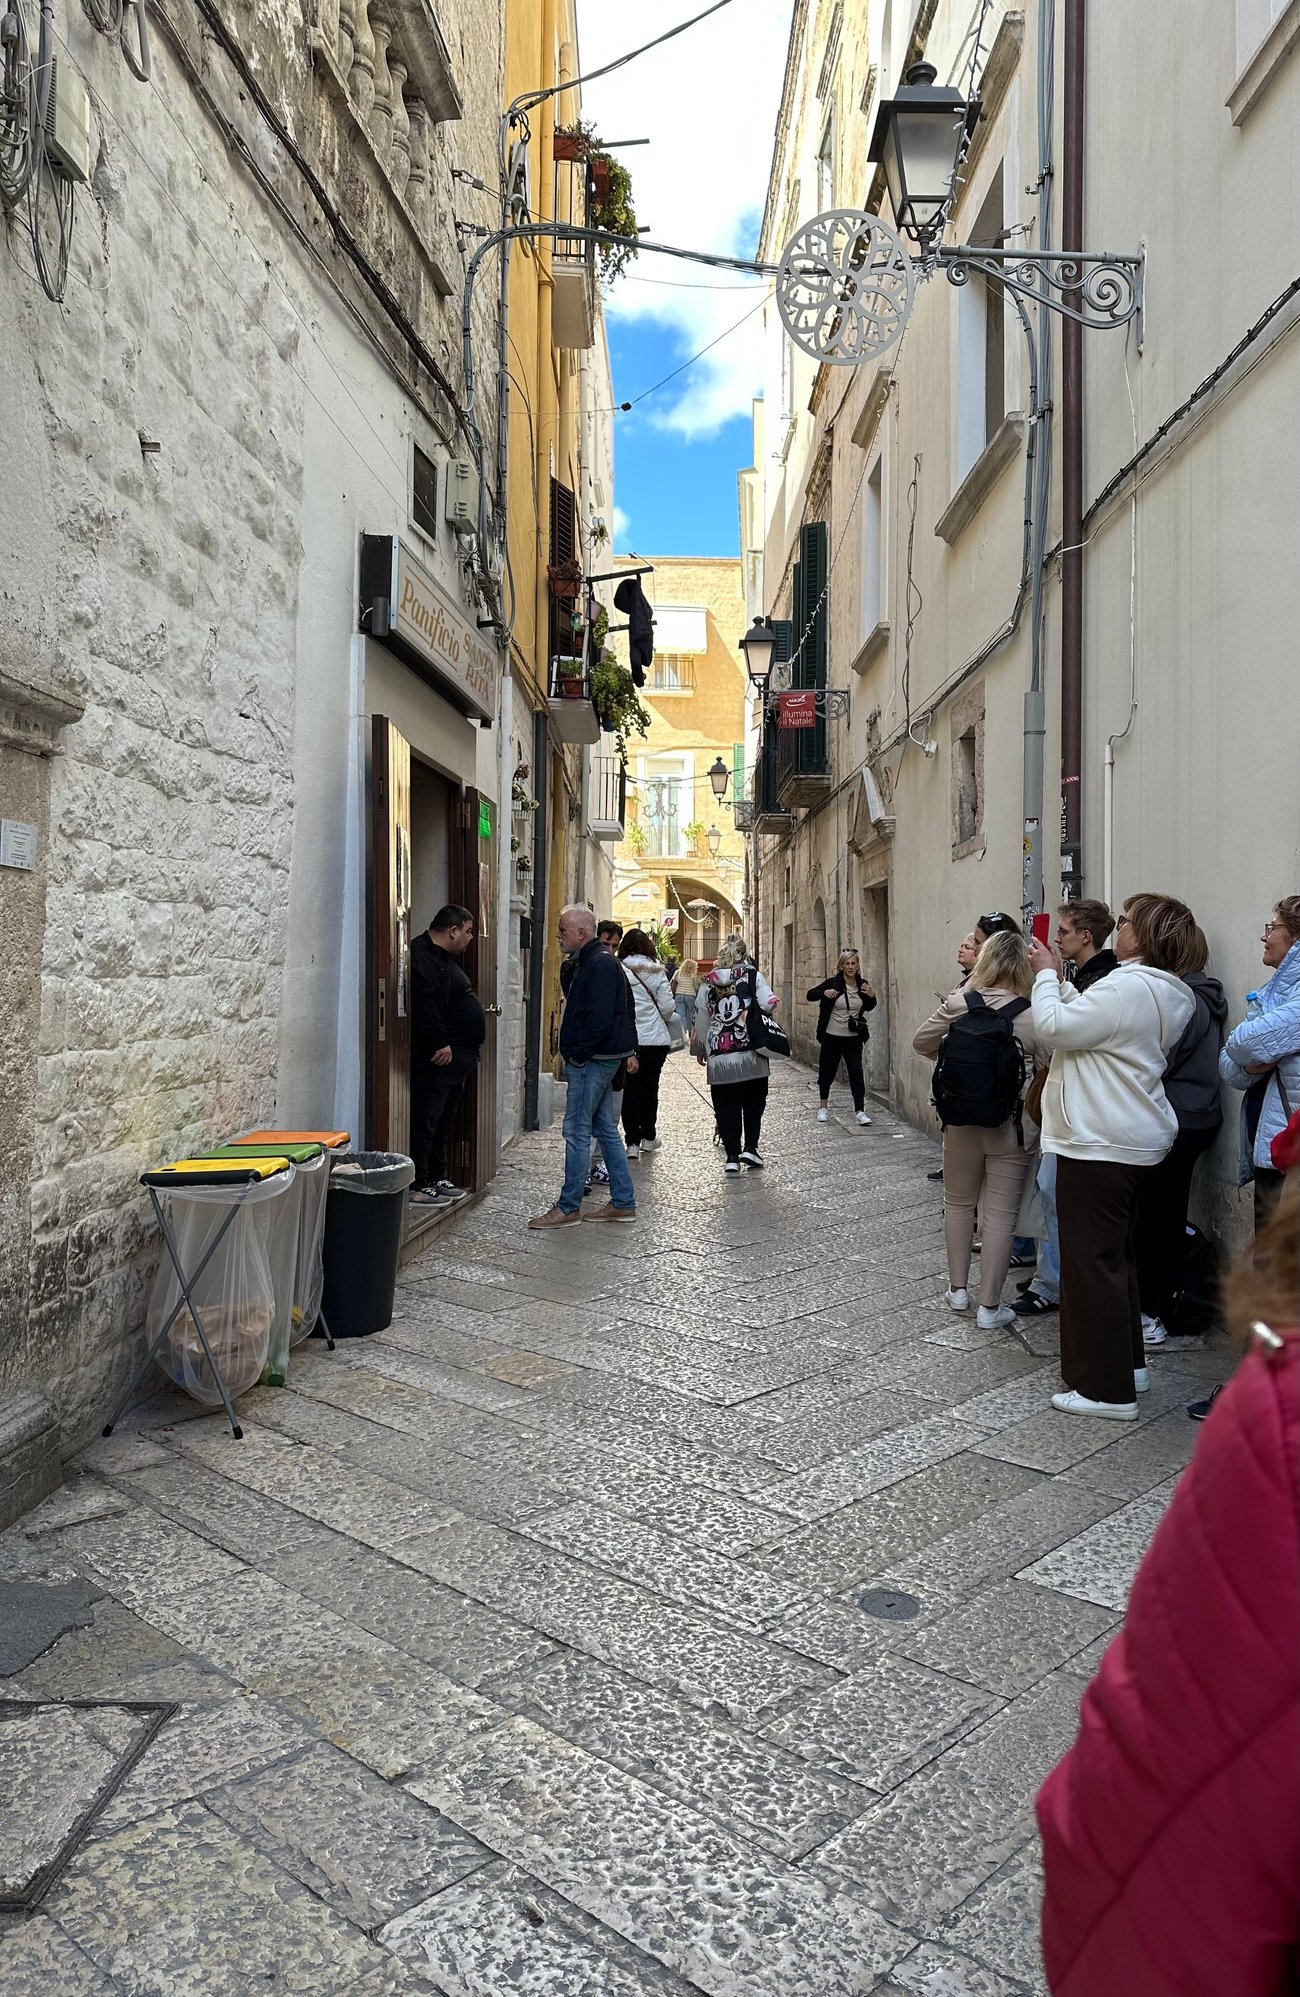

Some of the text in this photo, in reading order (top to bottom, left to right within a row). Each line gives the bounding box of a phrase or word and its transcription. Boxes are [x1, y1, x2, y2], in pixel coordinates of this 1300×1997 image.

[400, 577, 460, 663] Panificio
[463, 633, 494, 680] SANTA
[782, 710, 813, 718] illumina
[782, 717, 813, 726] il Natale
